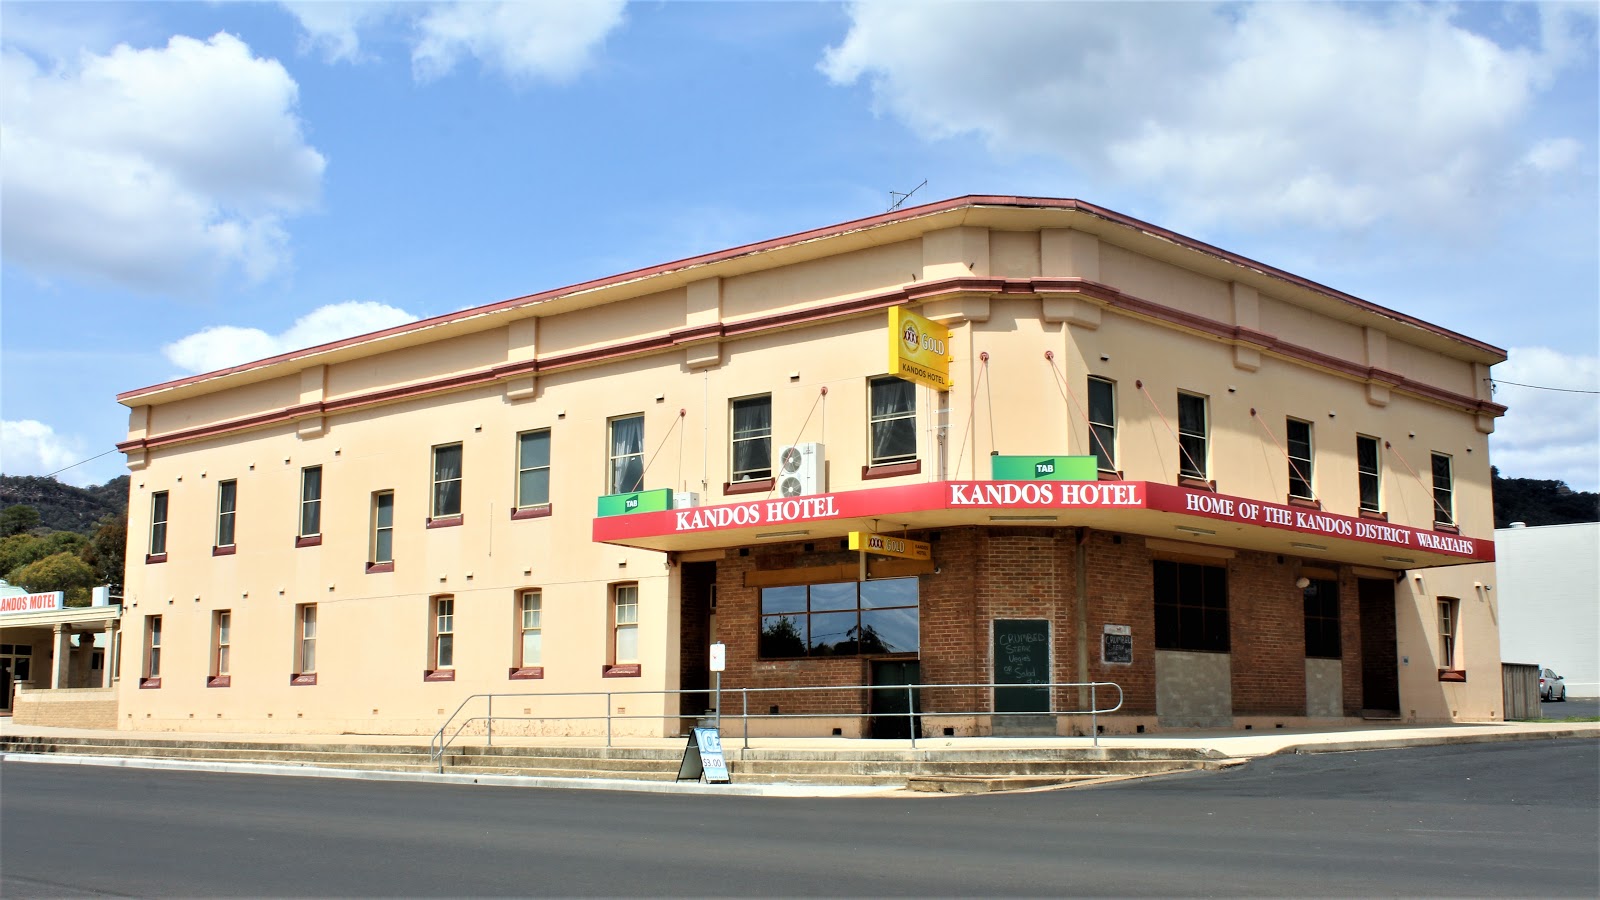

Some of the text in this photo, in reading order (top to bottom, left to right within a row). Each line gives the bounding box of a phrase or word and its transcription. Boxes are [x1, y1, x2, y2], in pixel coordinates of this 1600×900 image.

[903, 330, 945, 355] XXXX GOLD
[902, 363, 945, 385] KANDOS HOTEL
[1036, 464, 1054, 473] TAB
[950, 484, 1142, 505] KANDOS HOTEL
[626, 499, 638, 508] TAB
[675, 496, 839, 531] KANDOS HOTEL
[1185, 493, 1474, 555] HOME OF THE KANDOS DISTRICT WARATAHS
[886, 539, 905, 553] GOLD
[0, 594, 55, 611] ANDOS MOTEL
[1000, 633, 1046, 646] CRUMBED
[703, 758, 722, 768] $3.00
